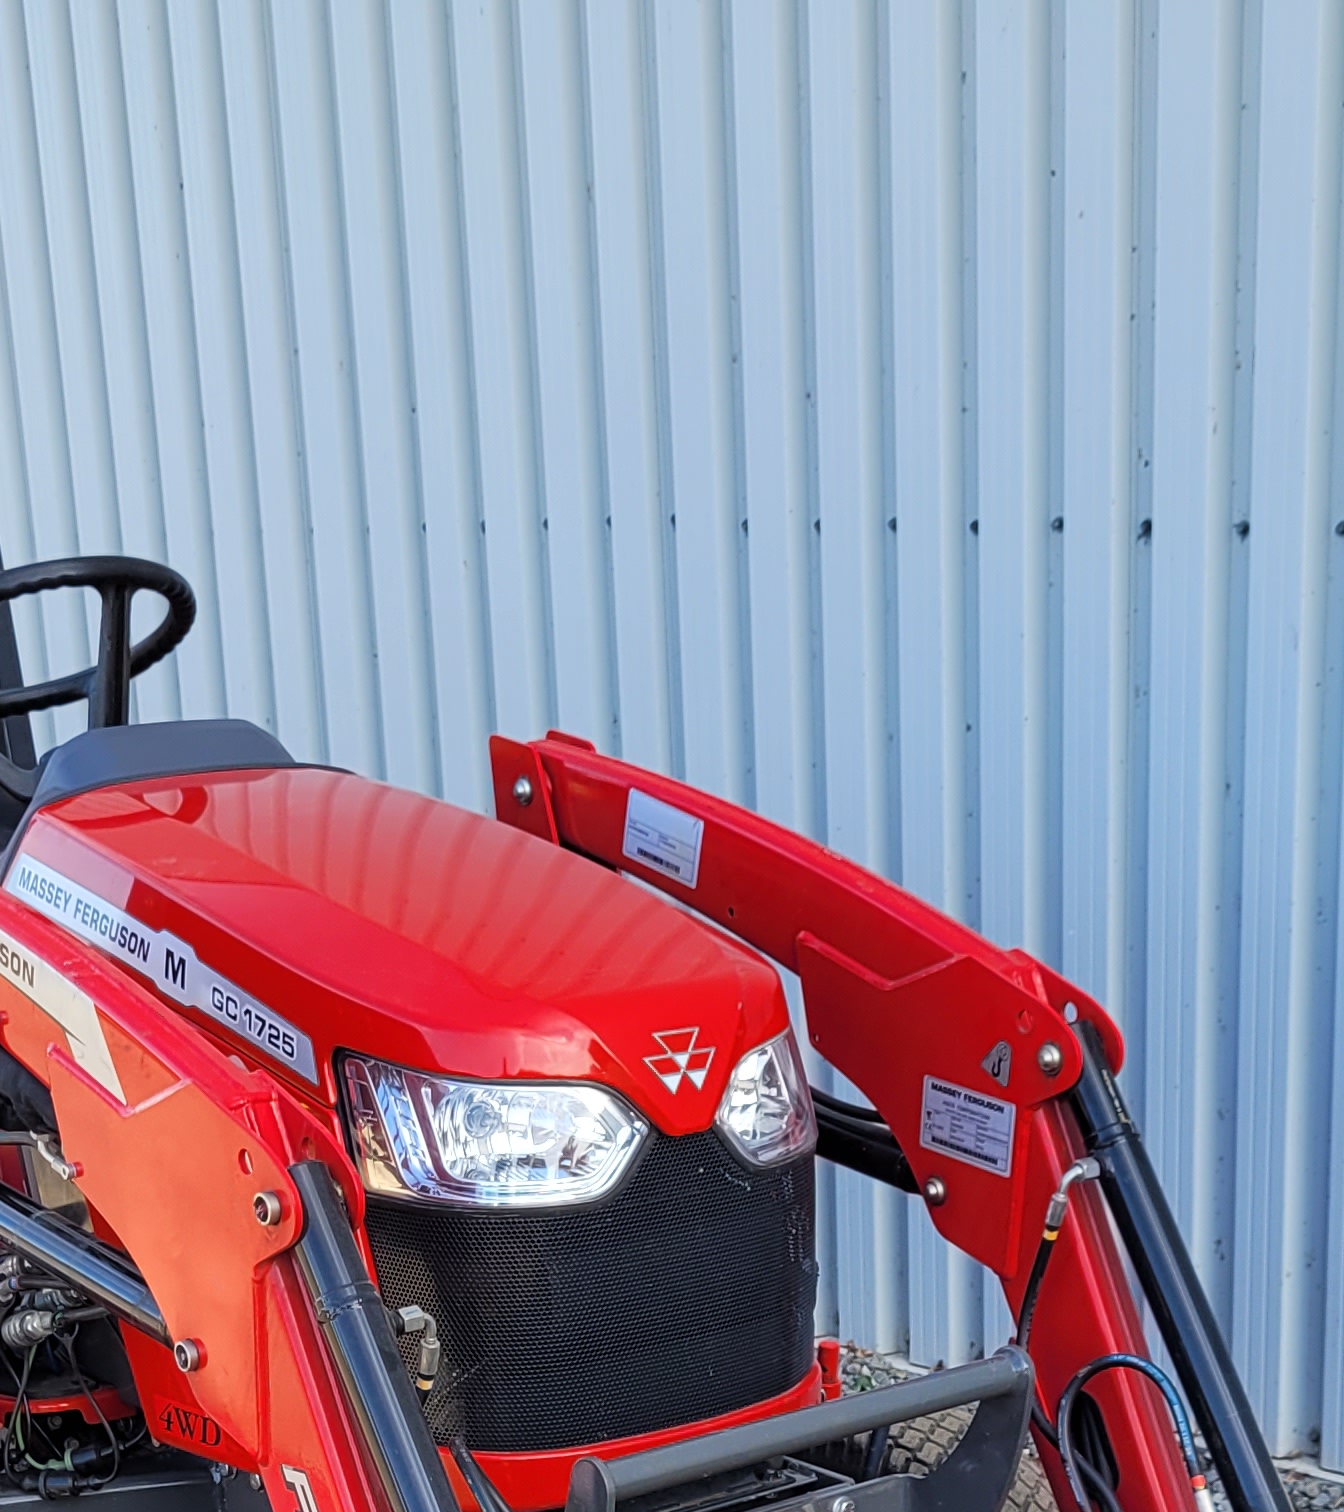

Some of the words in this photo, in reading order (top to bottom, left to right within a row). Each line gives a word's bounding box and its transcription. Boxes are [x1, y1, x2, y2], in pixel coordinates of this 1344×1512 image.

[18, 866, 73, 914] MASSEY
[73, 898, 151, 963] FERGUSON
[164, 947, 187, 990] M
[158, 1403, 222, 1447] 4WD
